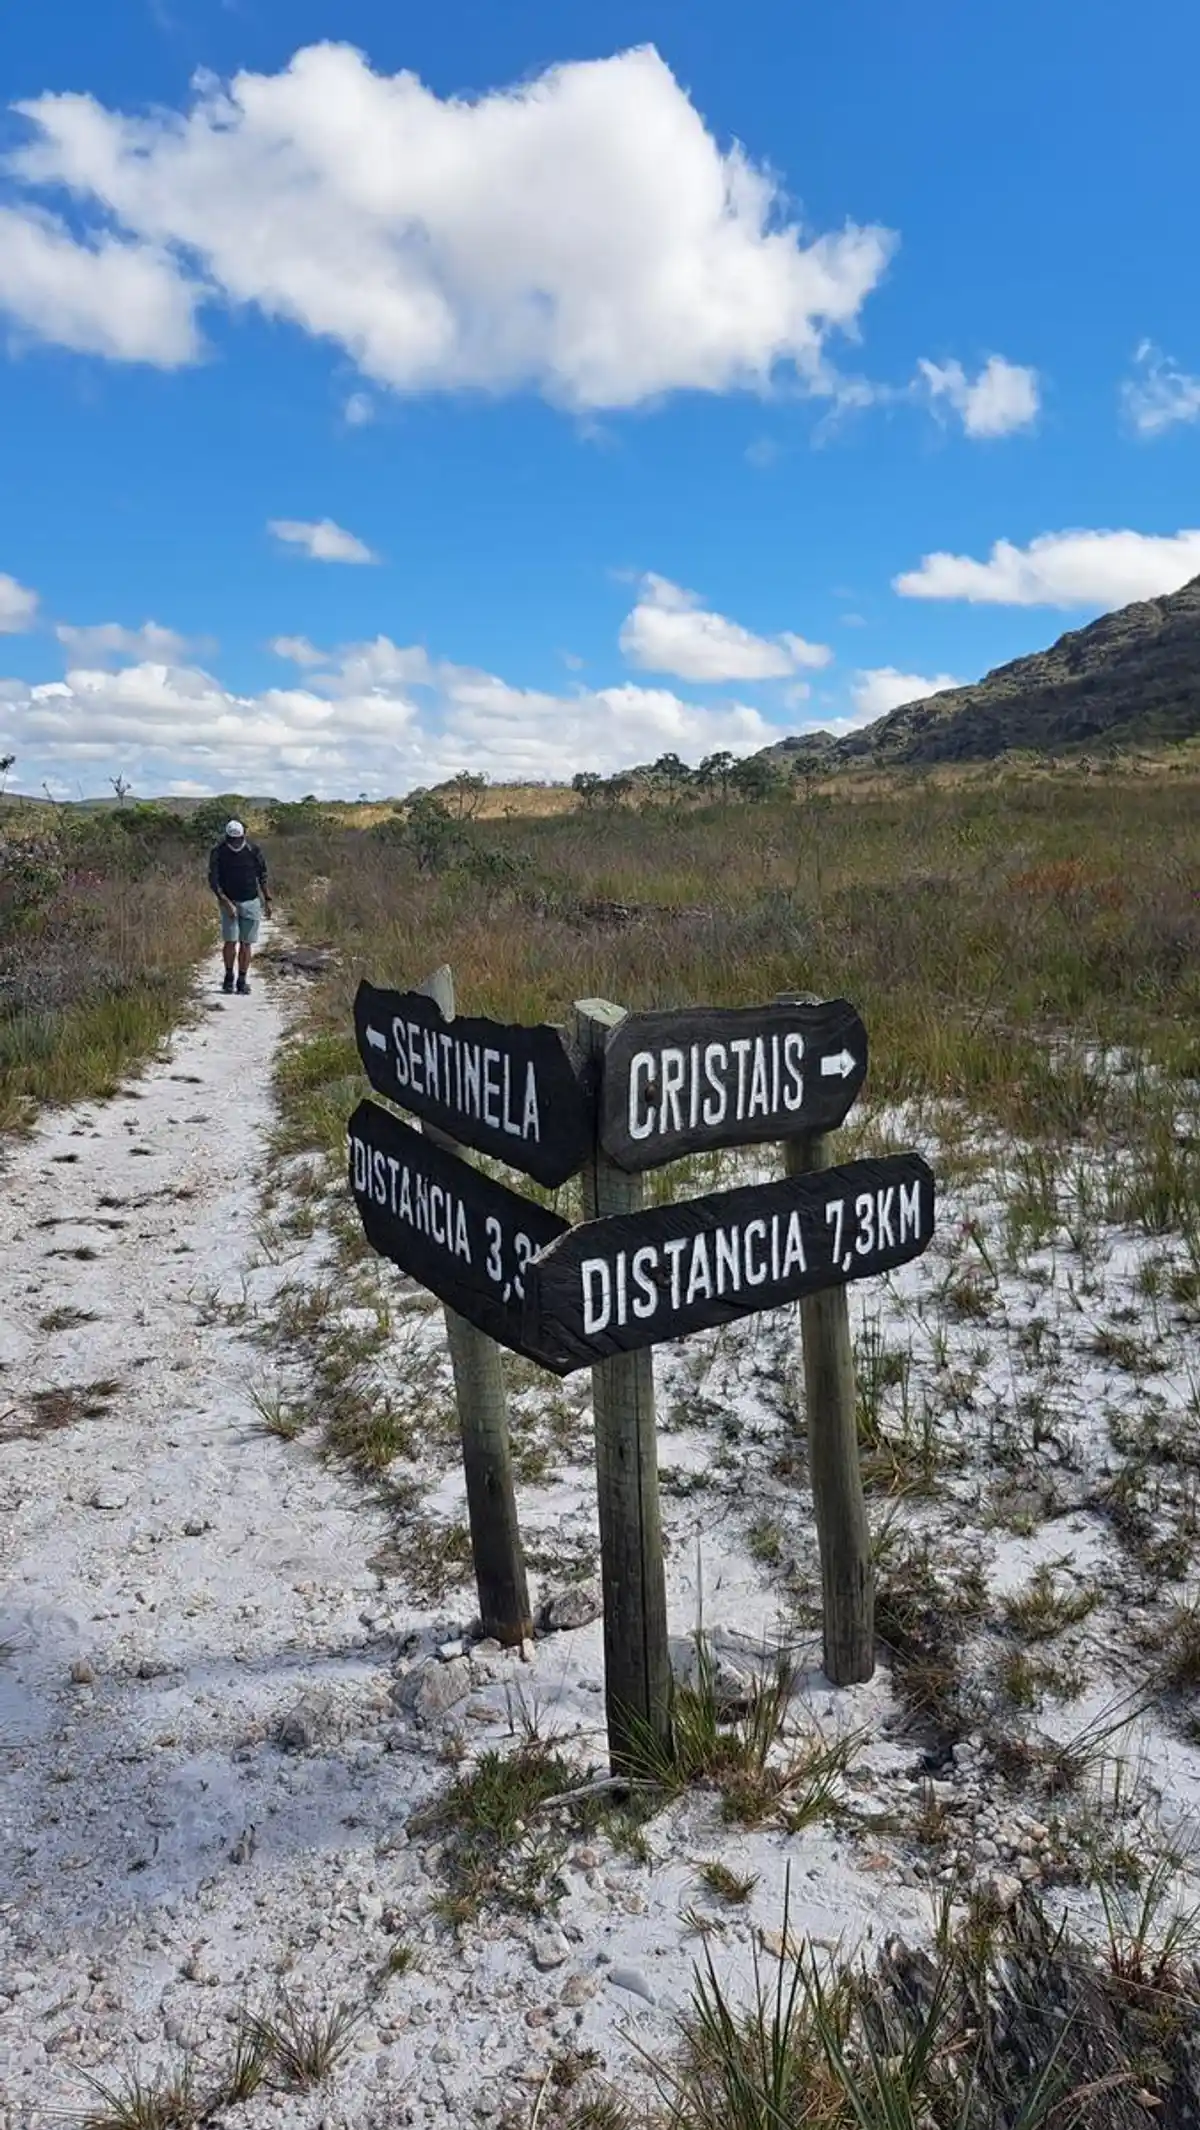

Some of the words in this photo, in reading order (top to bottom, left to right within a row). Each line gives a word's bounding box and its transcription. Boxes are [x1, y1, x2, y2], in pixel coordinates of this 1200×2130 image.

[392, 1016, 540, 1143] SENTINELA
[628, 1032, 806, 1140] CRISTAIS
[353, 1136, 471, 1264] DISTANCIA
[485, 1216, 541, 1302] 3,3
[580, 1211, 807, 1335] DISTANCIA
[825, 1180, 921, 1272] 7,3KM
